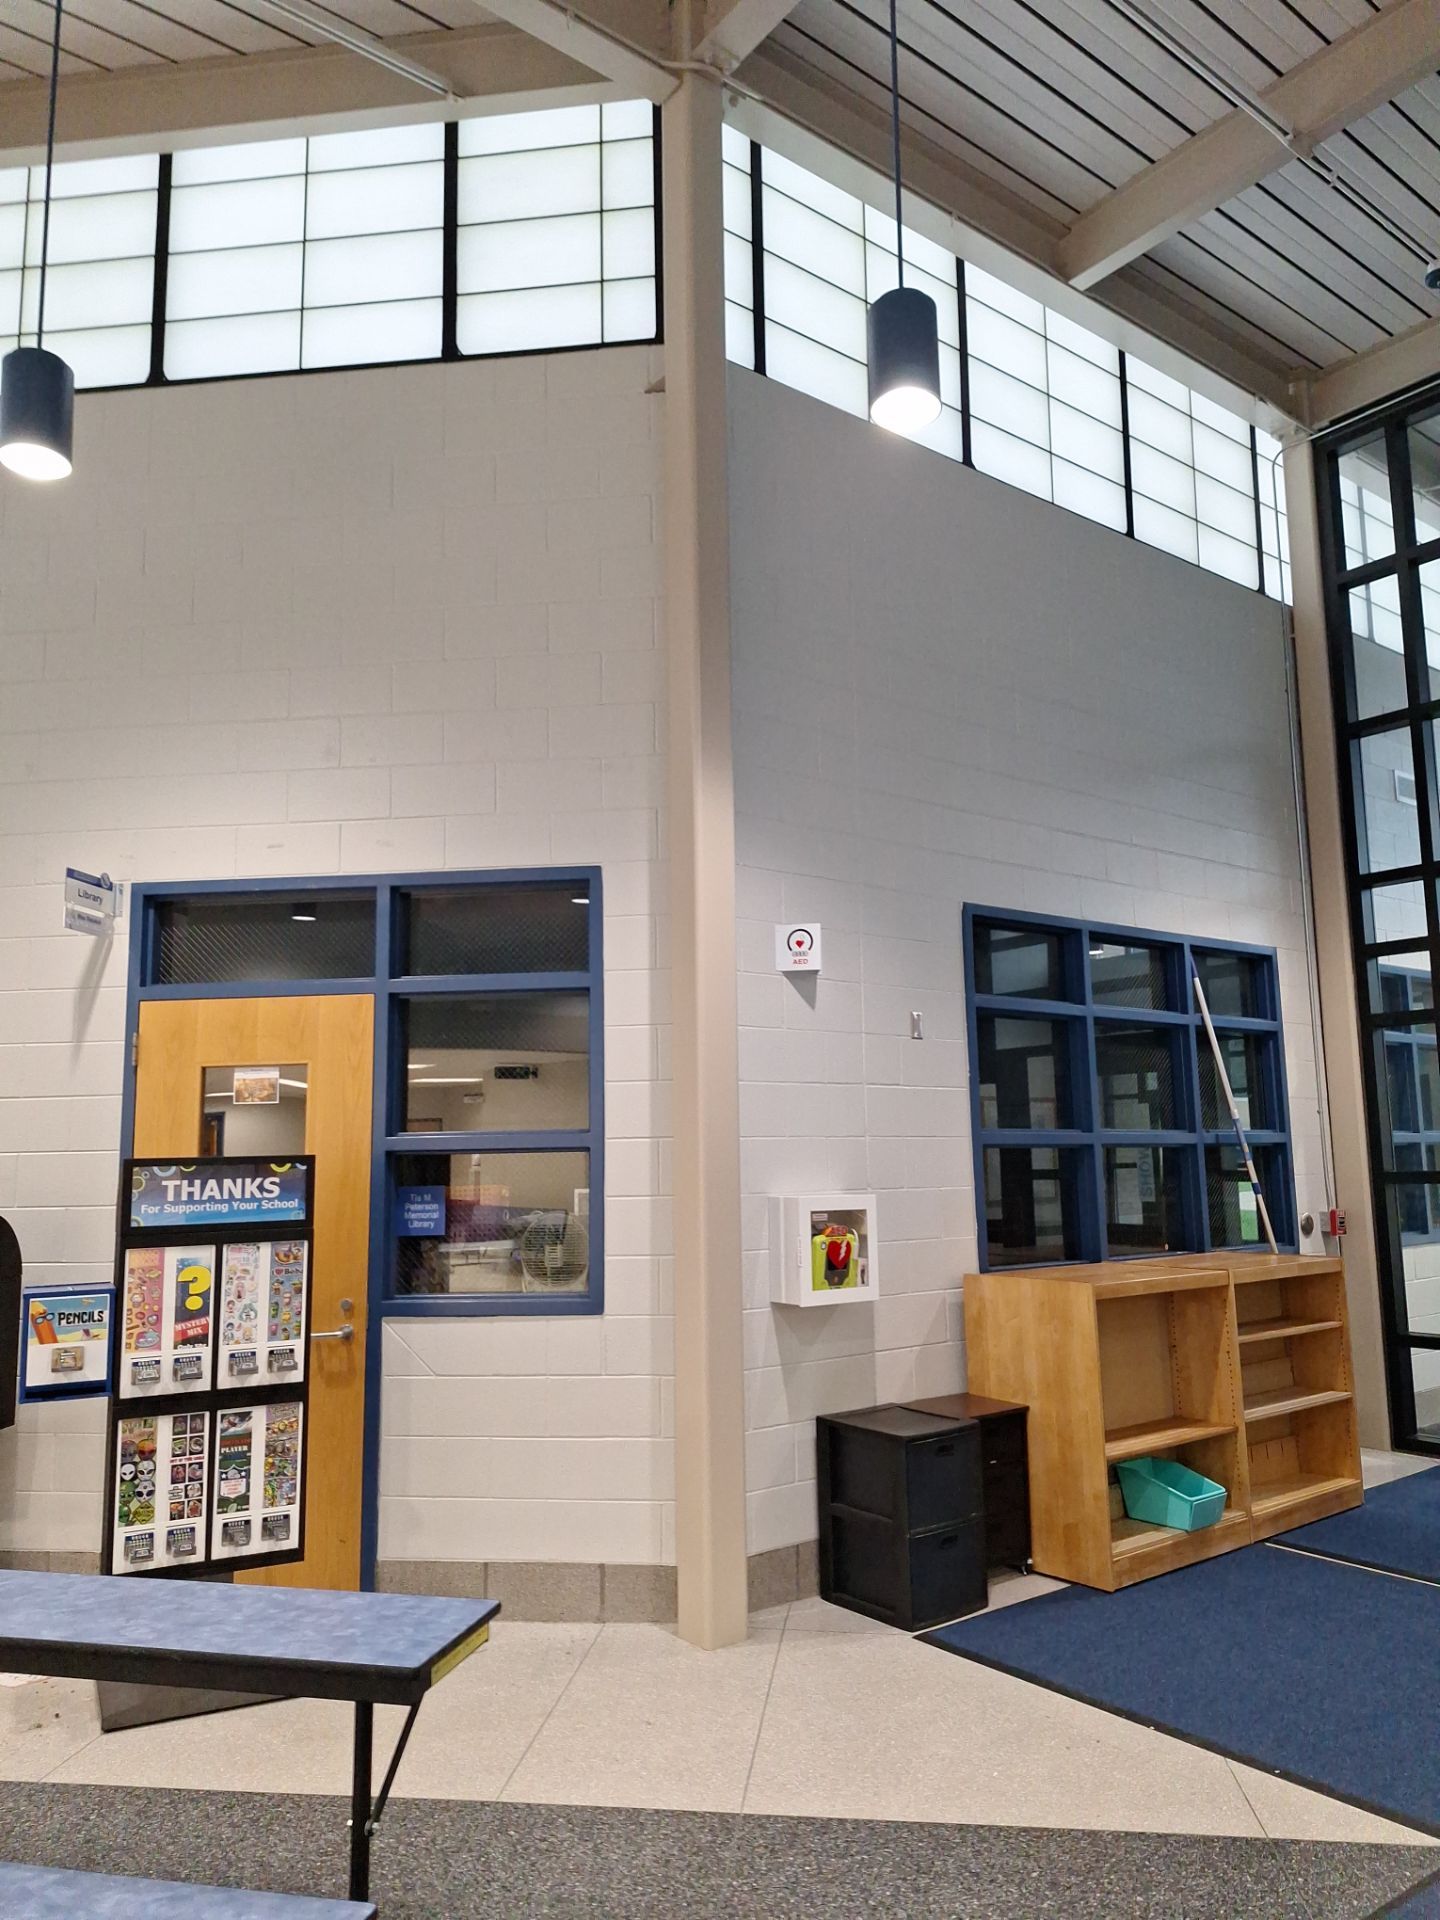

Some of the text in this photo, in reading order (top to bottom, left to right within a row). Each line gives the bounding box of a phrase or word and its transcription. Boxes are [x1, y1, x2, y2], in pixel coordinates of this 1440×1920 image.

[78, 888, 102, 905] Library
[162, 1176, 281, 1202] THANKS
[141, 1199, 299, 1214] For Supporting Your School
[404, 1202, 439, 1210] Peterson
[404, 1211, 440, 1219] Memorial
[408, 1220, 435, 1229] Library
[57, 1311, 104, 1325] PENCILS
[187, 1326, 203, 1336] MIX
[221, 1445, 248, 1454] PLAYER
